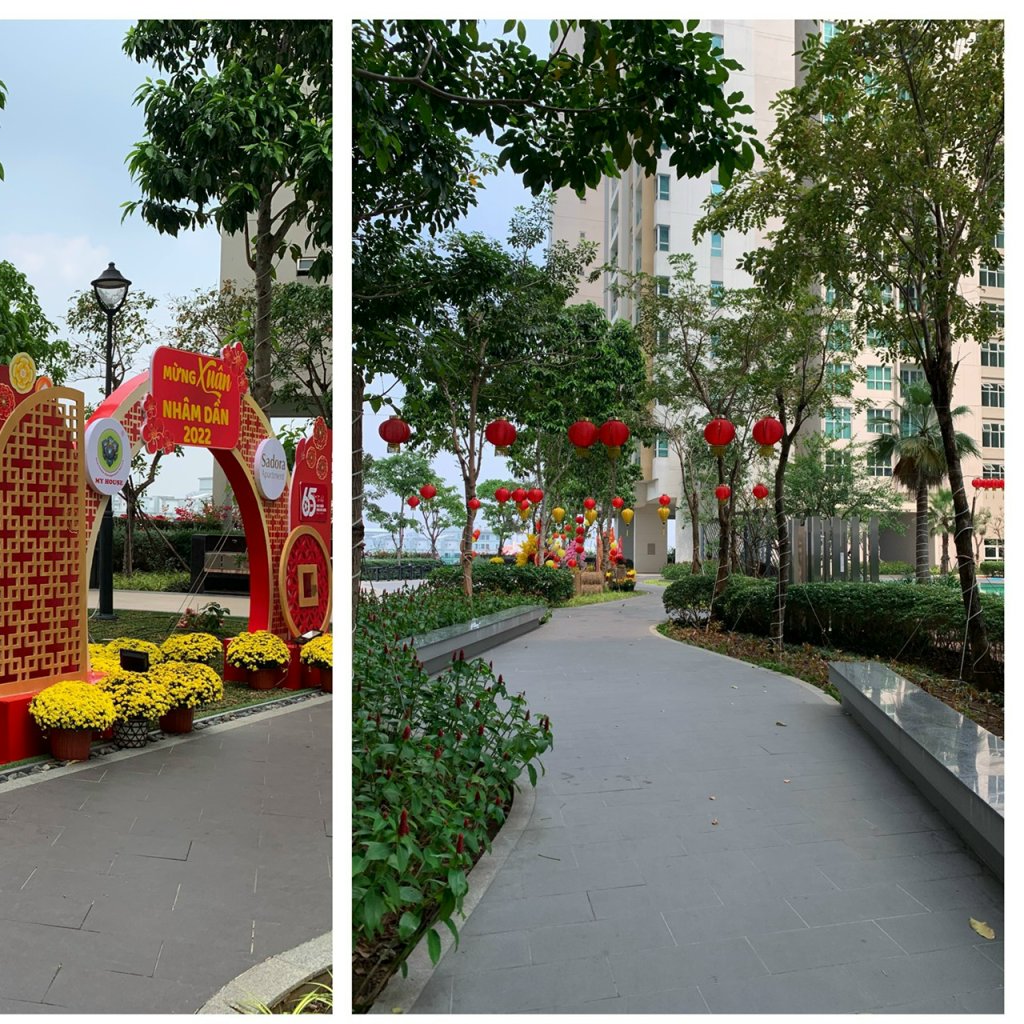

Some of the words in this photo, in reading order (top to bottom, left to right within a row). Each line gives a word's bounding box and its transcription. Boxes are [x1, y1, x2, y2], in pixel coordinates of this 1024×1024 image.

[163, 362, 196, 385] MỪNG
[196, 357, 233, 399] Xuân
[163, 396, 202, 423] NHÂM
[204, 398, 229, 426] DẦN
[183, 425, 212, 445] 2022
[261, 453, 286, 471] Sadora
[302, 486, 317, 518] 65
